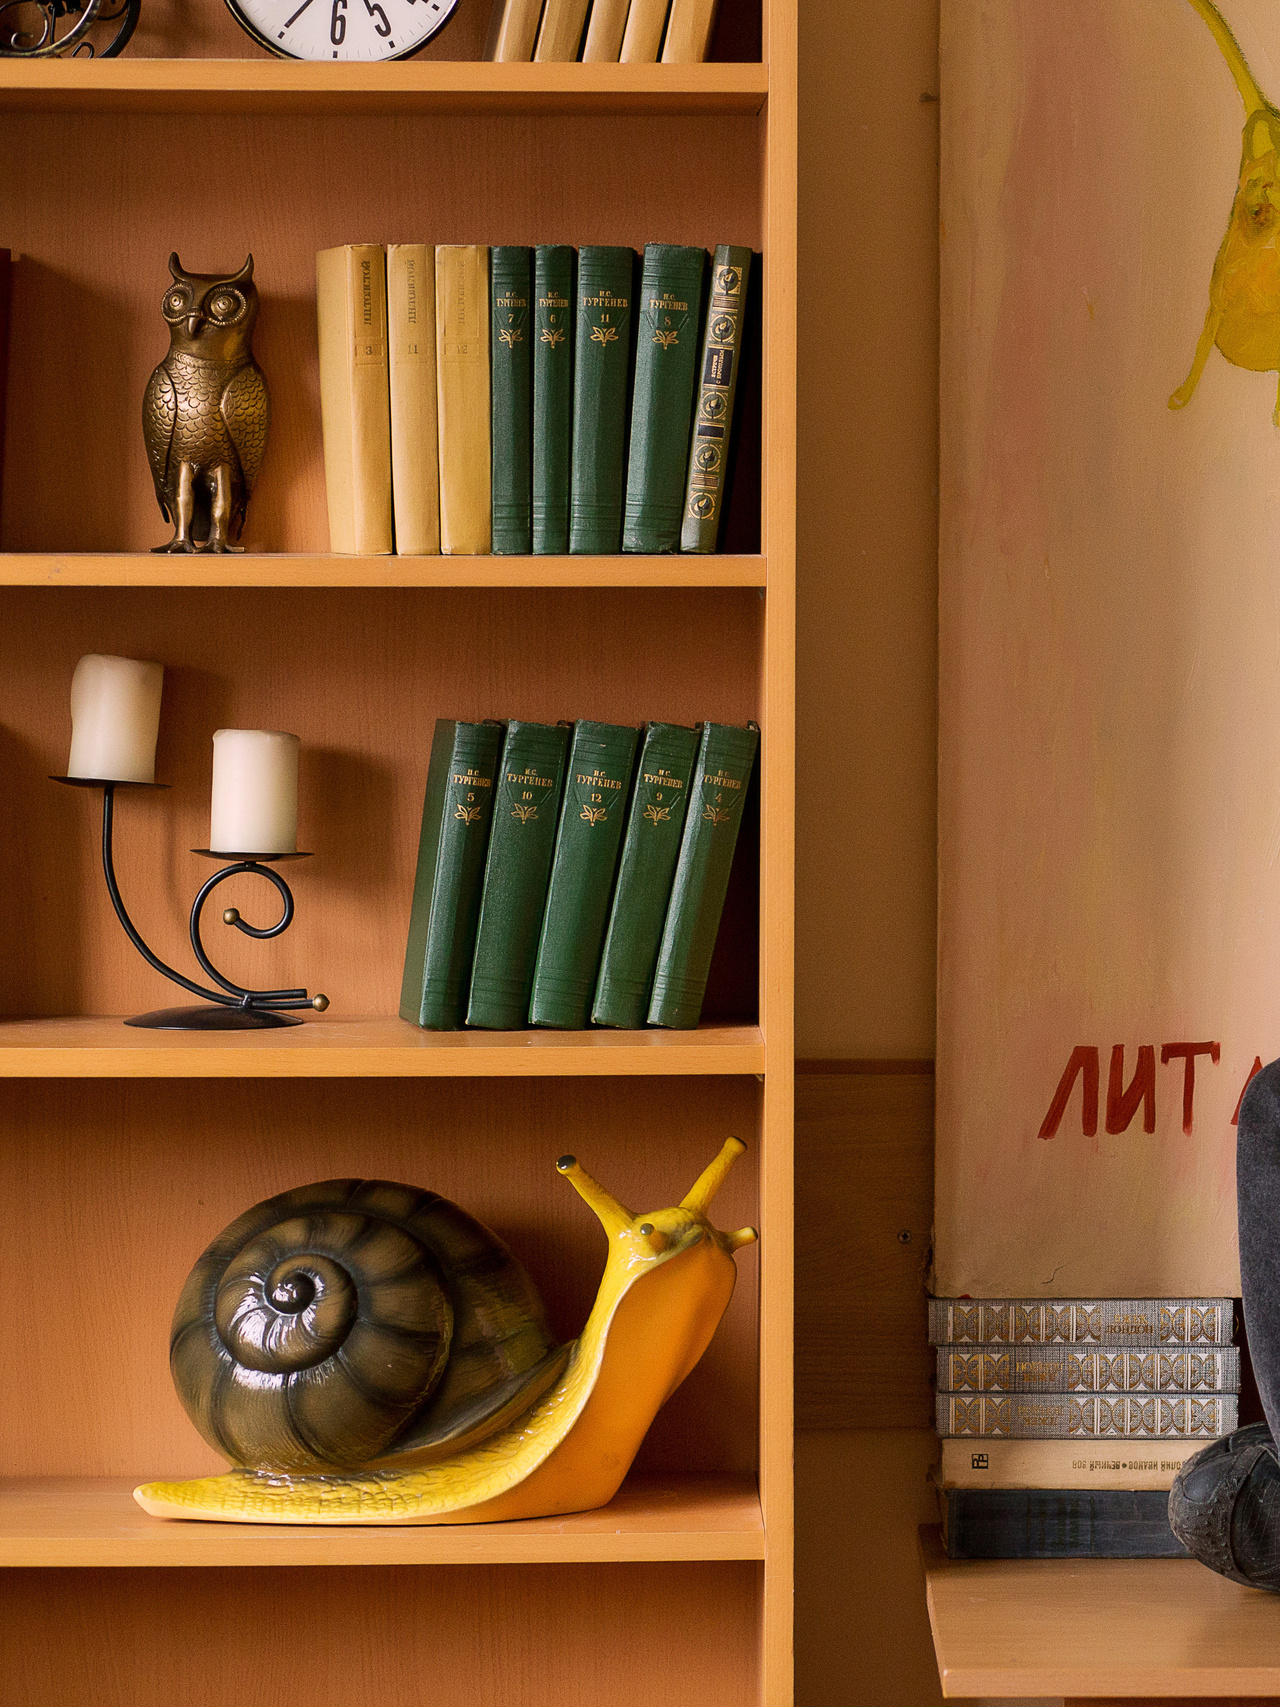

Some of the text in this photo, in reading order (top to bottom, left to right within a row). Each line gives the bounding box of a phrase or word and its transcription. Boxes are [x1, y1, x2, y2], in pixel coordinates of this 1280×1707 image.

[330, 0, 348, 46] 6
[496, 298, 527, 307] ТУРГЕНЕВ
[538, 298, 569, 308] ТУРГЕНЕВ
[583, 297, 628, 307] ТУРГЕНЕВ
[650, 300, 688, 311] ТУРГЕНЕВ
[508, 313, 514, 323] 7
[550, 313, 556, 324] 6
[600, 313, 609, 323] 11
[664, 316, 671, 326] 8
[365, 345, 373, 356] 3
[453, 774, 492, 788] ТУРГЕНЕВ
[507, 772, 553, 787] ТУРГЕНЕВ
[576, 774, 622, 790] ТУРГЕНЕВ
[644, 772, 683, 789] ТУРГЕНЕВ
[703, 774, 742, 789] ТУРГЕНЕВ
[466, 792, 475, 802] 5
[521, 791, 533, 800] 10
[590, 793, 602, 803] 12
[656, 791, 663, 802] 9
[714, 792, 722, 802] 4
[1037, 1041, 1221, 1140] ЛИТ
[1112, 1314, 1149, 1324] ДЖЕК
[1106, 1324, 1154, 1335] ЛОНДОН
[1016, 1362, 1065, 1373] ЛОНДОН
[1072, 1460, 1182, 1472] ОЛИЙ ИВАНОВ ВЕЧНЫЙ ЗОВ
